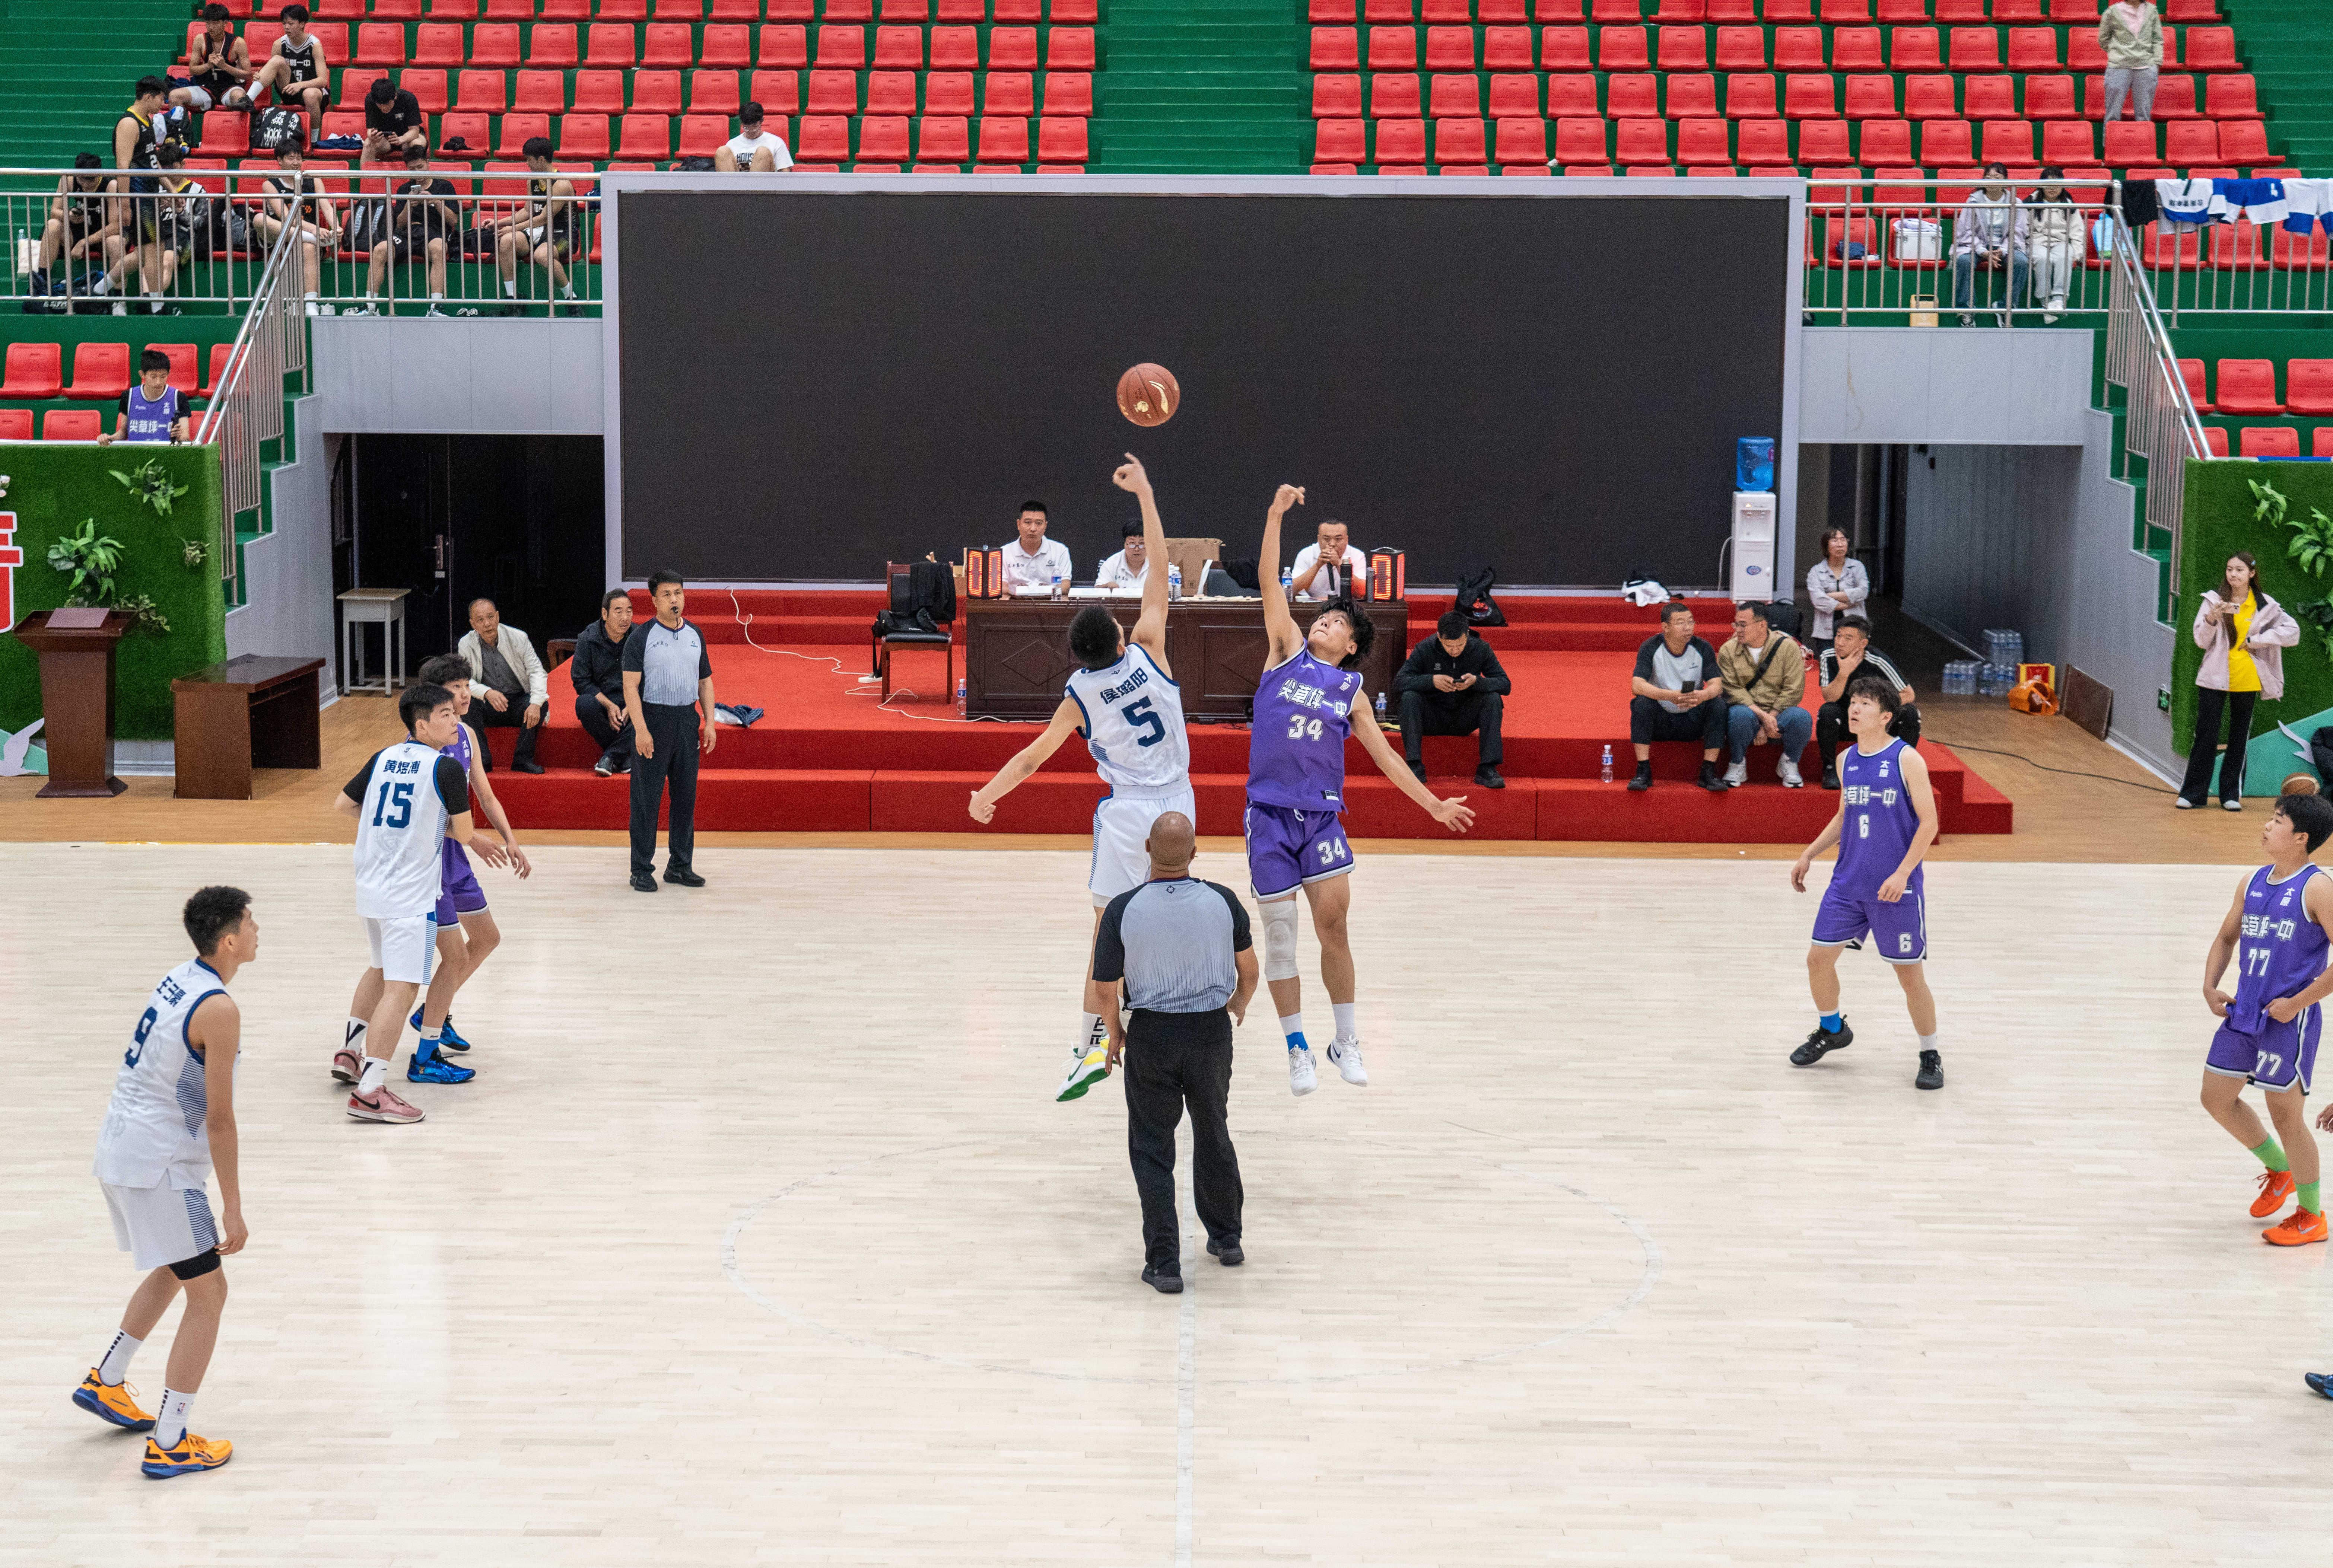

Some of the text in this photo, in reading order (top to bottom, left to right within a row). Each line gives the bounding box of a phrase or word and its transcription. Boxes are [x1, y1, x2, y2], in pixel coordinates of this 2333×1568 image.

[1372, 554, 1392, 600] 0
[1100, 667, 1148, 705] 侯璐阳
[1276, 678, 1348, 718] 尖草坪一中
[1121, 695, 1166, 748] 5
[1287, 713, 1324, 742] 34
[373, 781, 415, 829] 15
[1859, 813, 1870, 839] 6
[1317, 836, 1346, 865] 34
[2280, 887, 2295, 906] 太原
[1899, 932, 1913, 953] 6
[2248, 947, 2271, 977] 77
[125, 1006, 158, 1070] 9
[2255, 1049, 2282, 1077] 77
